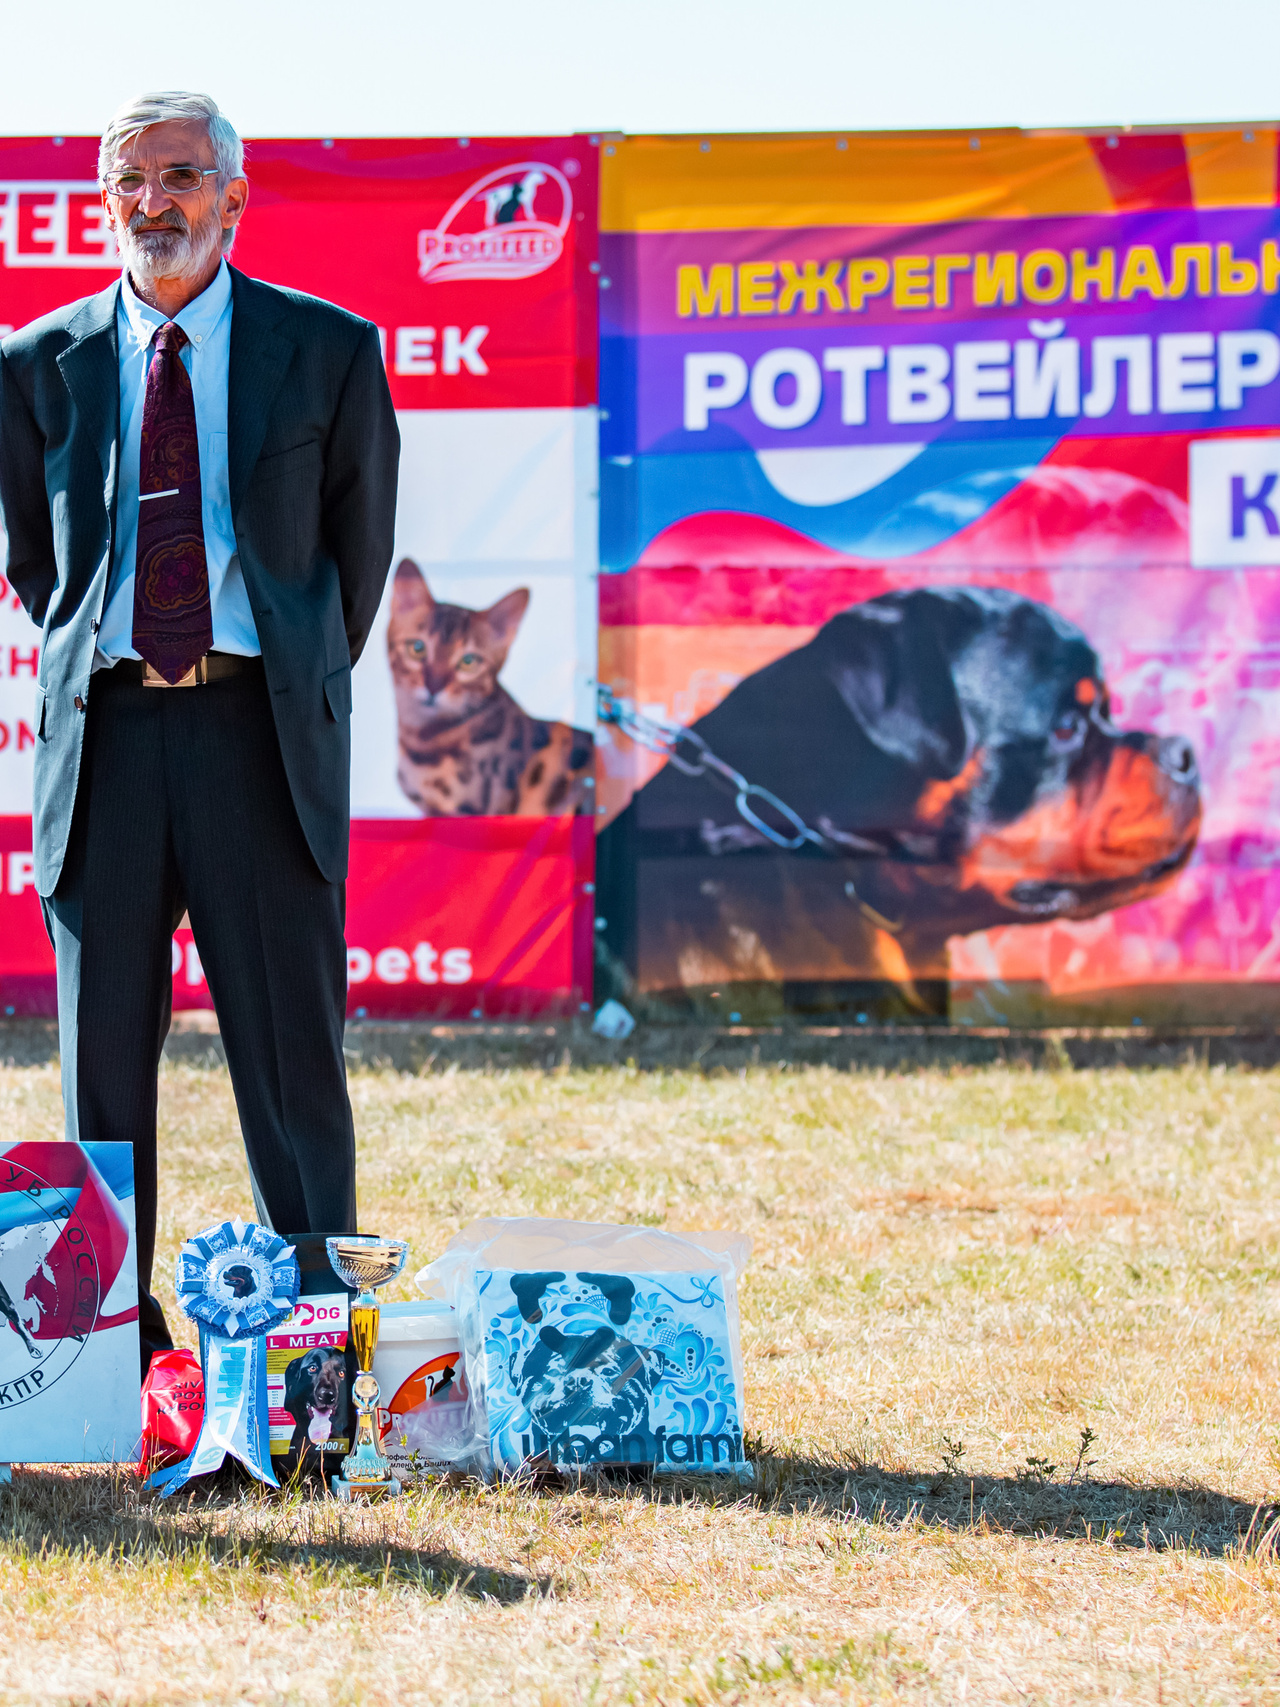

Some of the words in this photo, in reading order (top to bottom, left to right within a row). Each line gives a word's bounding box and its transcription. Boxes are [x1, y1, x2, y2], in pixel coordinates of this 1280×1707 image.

[379, 325, 489, 376] ЕК
[683, 318, 1280, 431] РОТВЕЙЛЕР
[51, 1203, 98, 1345] РОССИИ
[289, 1333, 341, 1347] MEAT
[214, 1346, 247, 1408] PUPPY
[157, 1402, 206, 1414] КУБО
[315, 1441, 338, 1451] 2000
